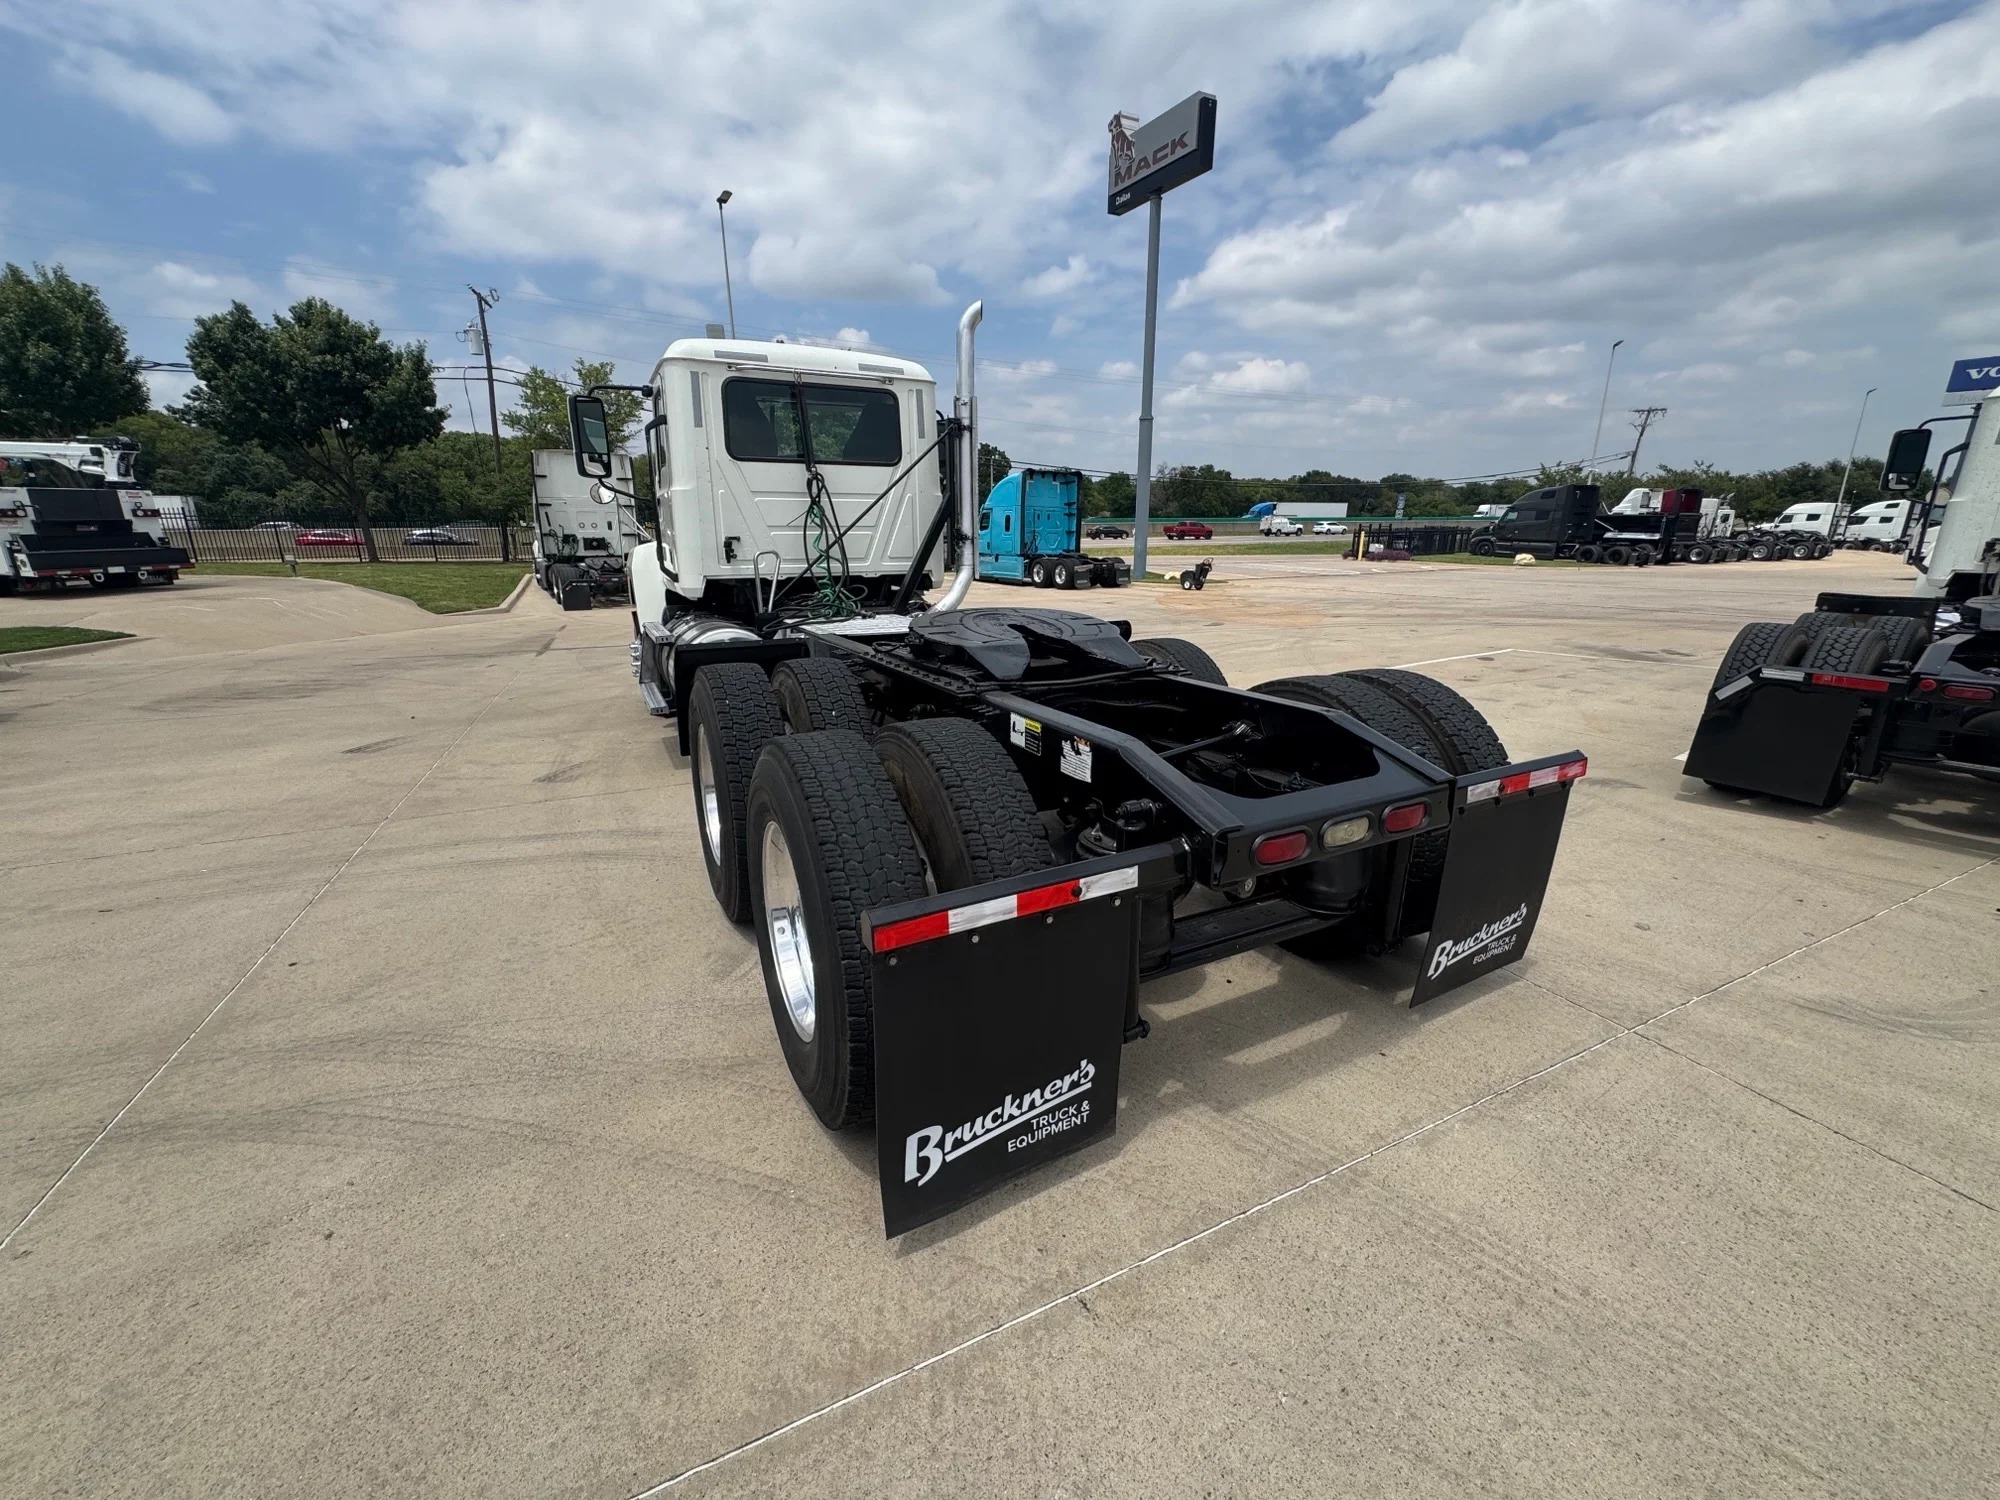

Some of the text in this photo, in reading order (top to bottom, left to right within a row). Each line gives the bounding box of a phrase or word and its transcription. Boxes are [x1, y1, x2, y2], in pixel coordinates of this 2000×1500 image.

[1114, 130, 1189, 188] MACK
[1427, 903, 1528, 980] Bruckner's
[1473, 942, 1515, 965] EQUIPMENT
[1487, 934, 1517, 951] TRUCK &
[905, 1059, 1095, 1187] Bruckner's
[1007, 1111, 1090, 1152] EQUIPMENT
[1030, 1100, 1090, 1130] TRUCK &
